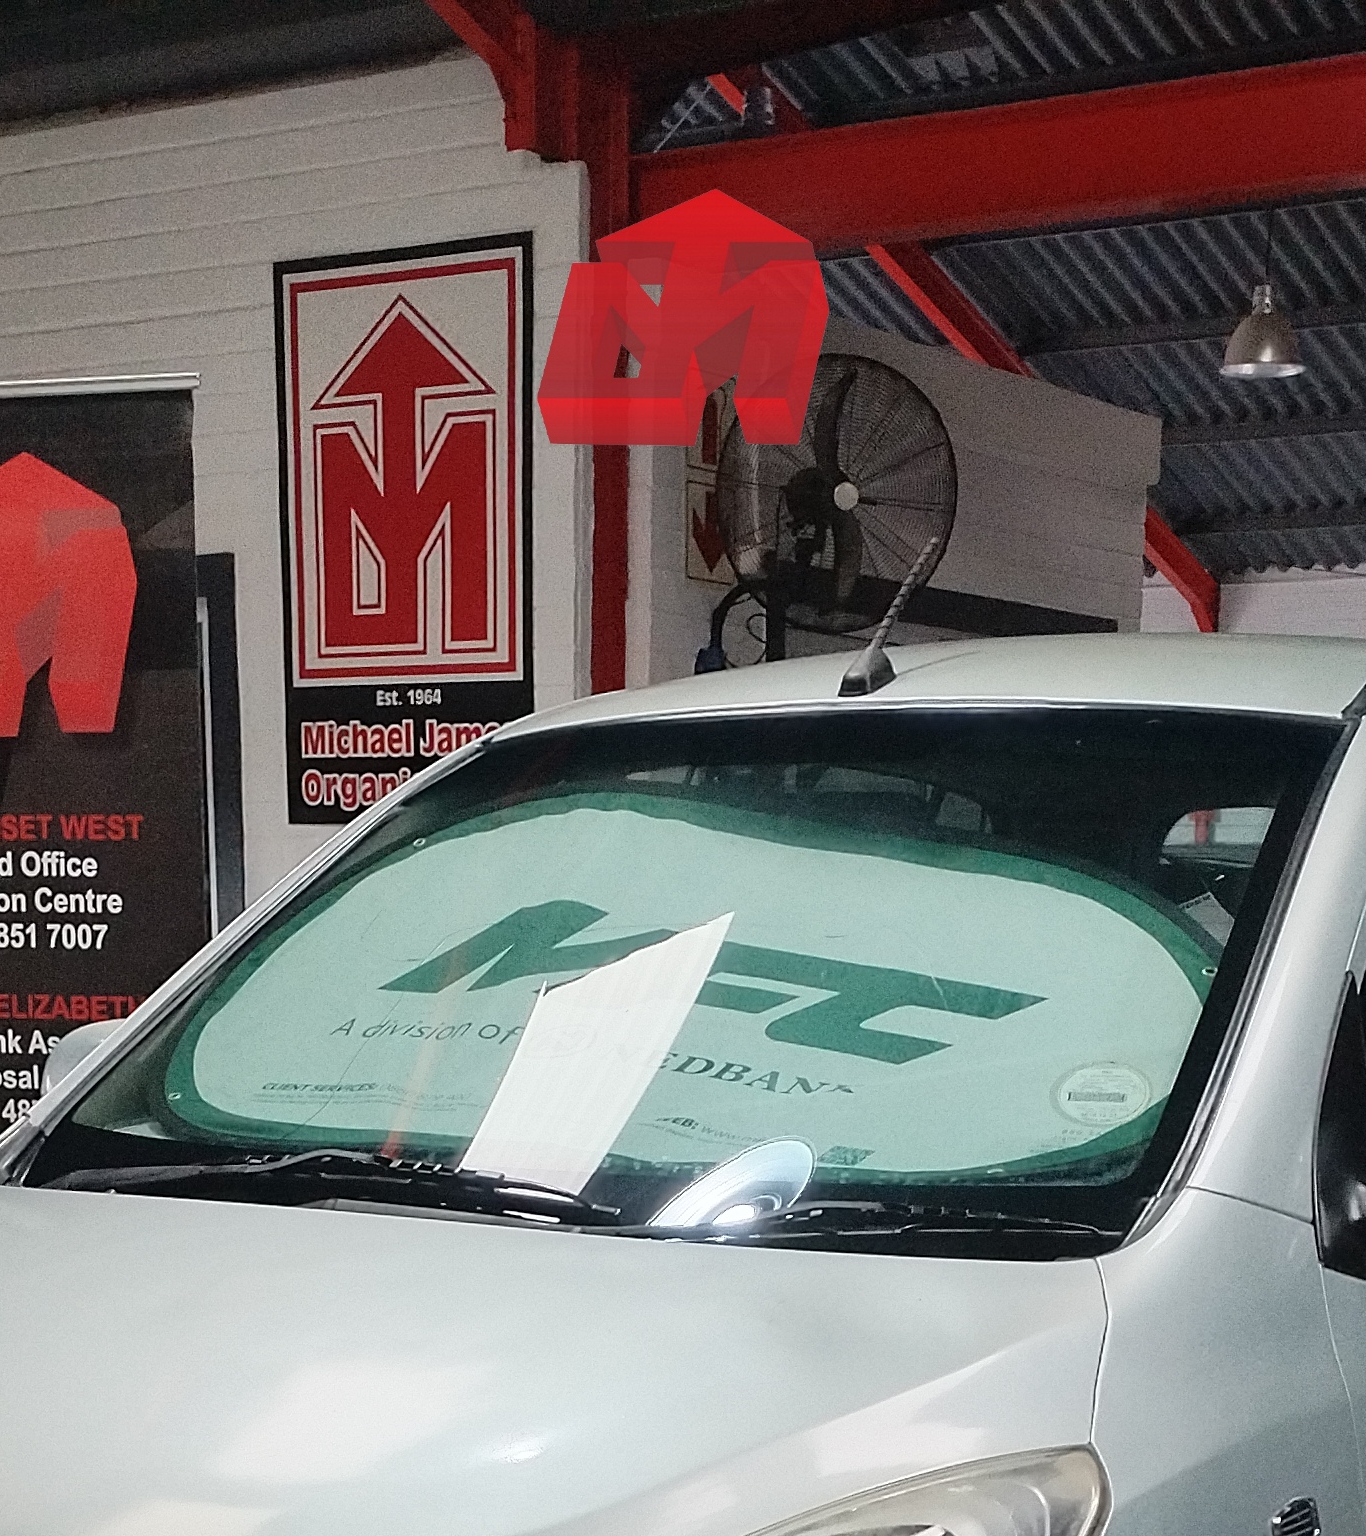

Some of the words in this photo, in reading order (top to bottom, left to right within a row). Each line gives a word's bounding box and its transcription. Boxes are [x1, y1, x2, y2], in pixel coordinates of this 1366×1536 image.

[376, 690, 403, 706] Est.
[407, 688, 442, 705] 1964
[301, 718, 415, 759] Michael
[420, 719, 503, 757] Jam
[60, 813, 144, 841] WEST
[20, 850, 98, 878] Office
[34, 886, 124, 914] Centre
[46, 923, 109, 950] 7007
[330, 1018, 356, 1036] A
[362, 1019, 472, 1041] division
[658, 1052, 855, 1094] DBANK
[1, 1098, 38, 1123] 48
